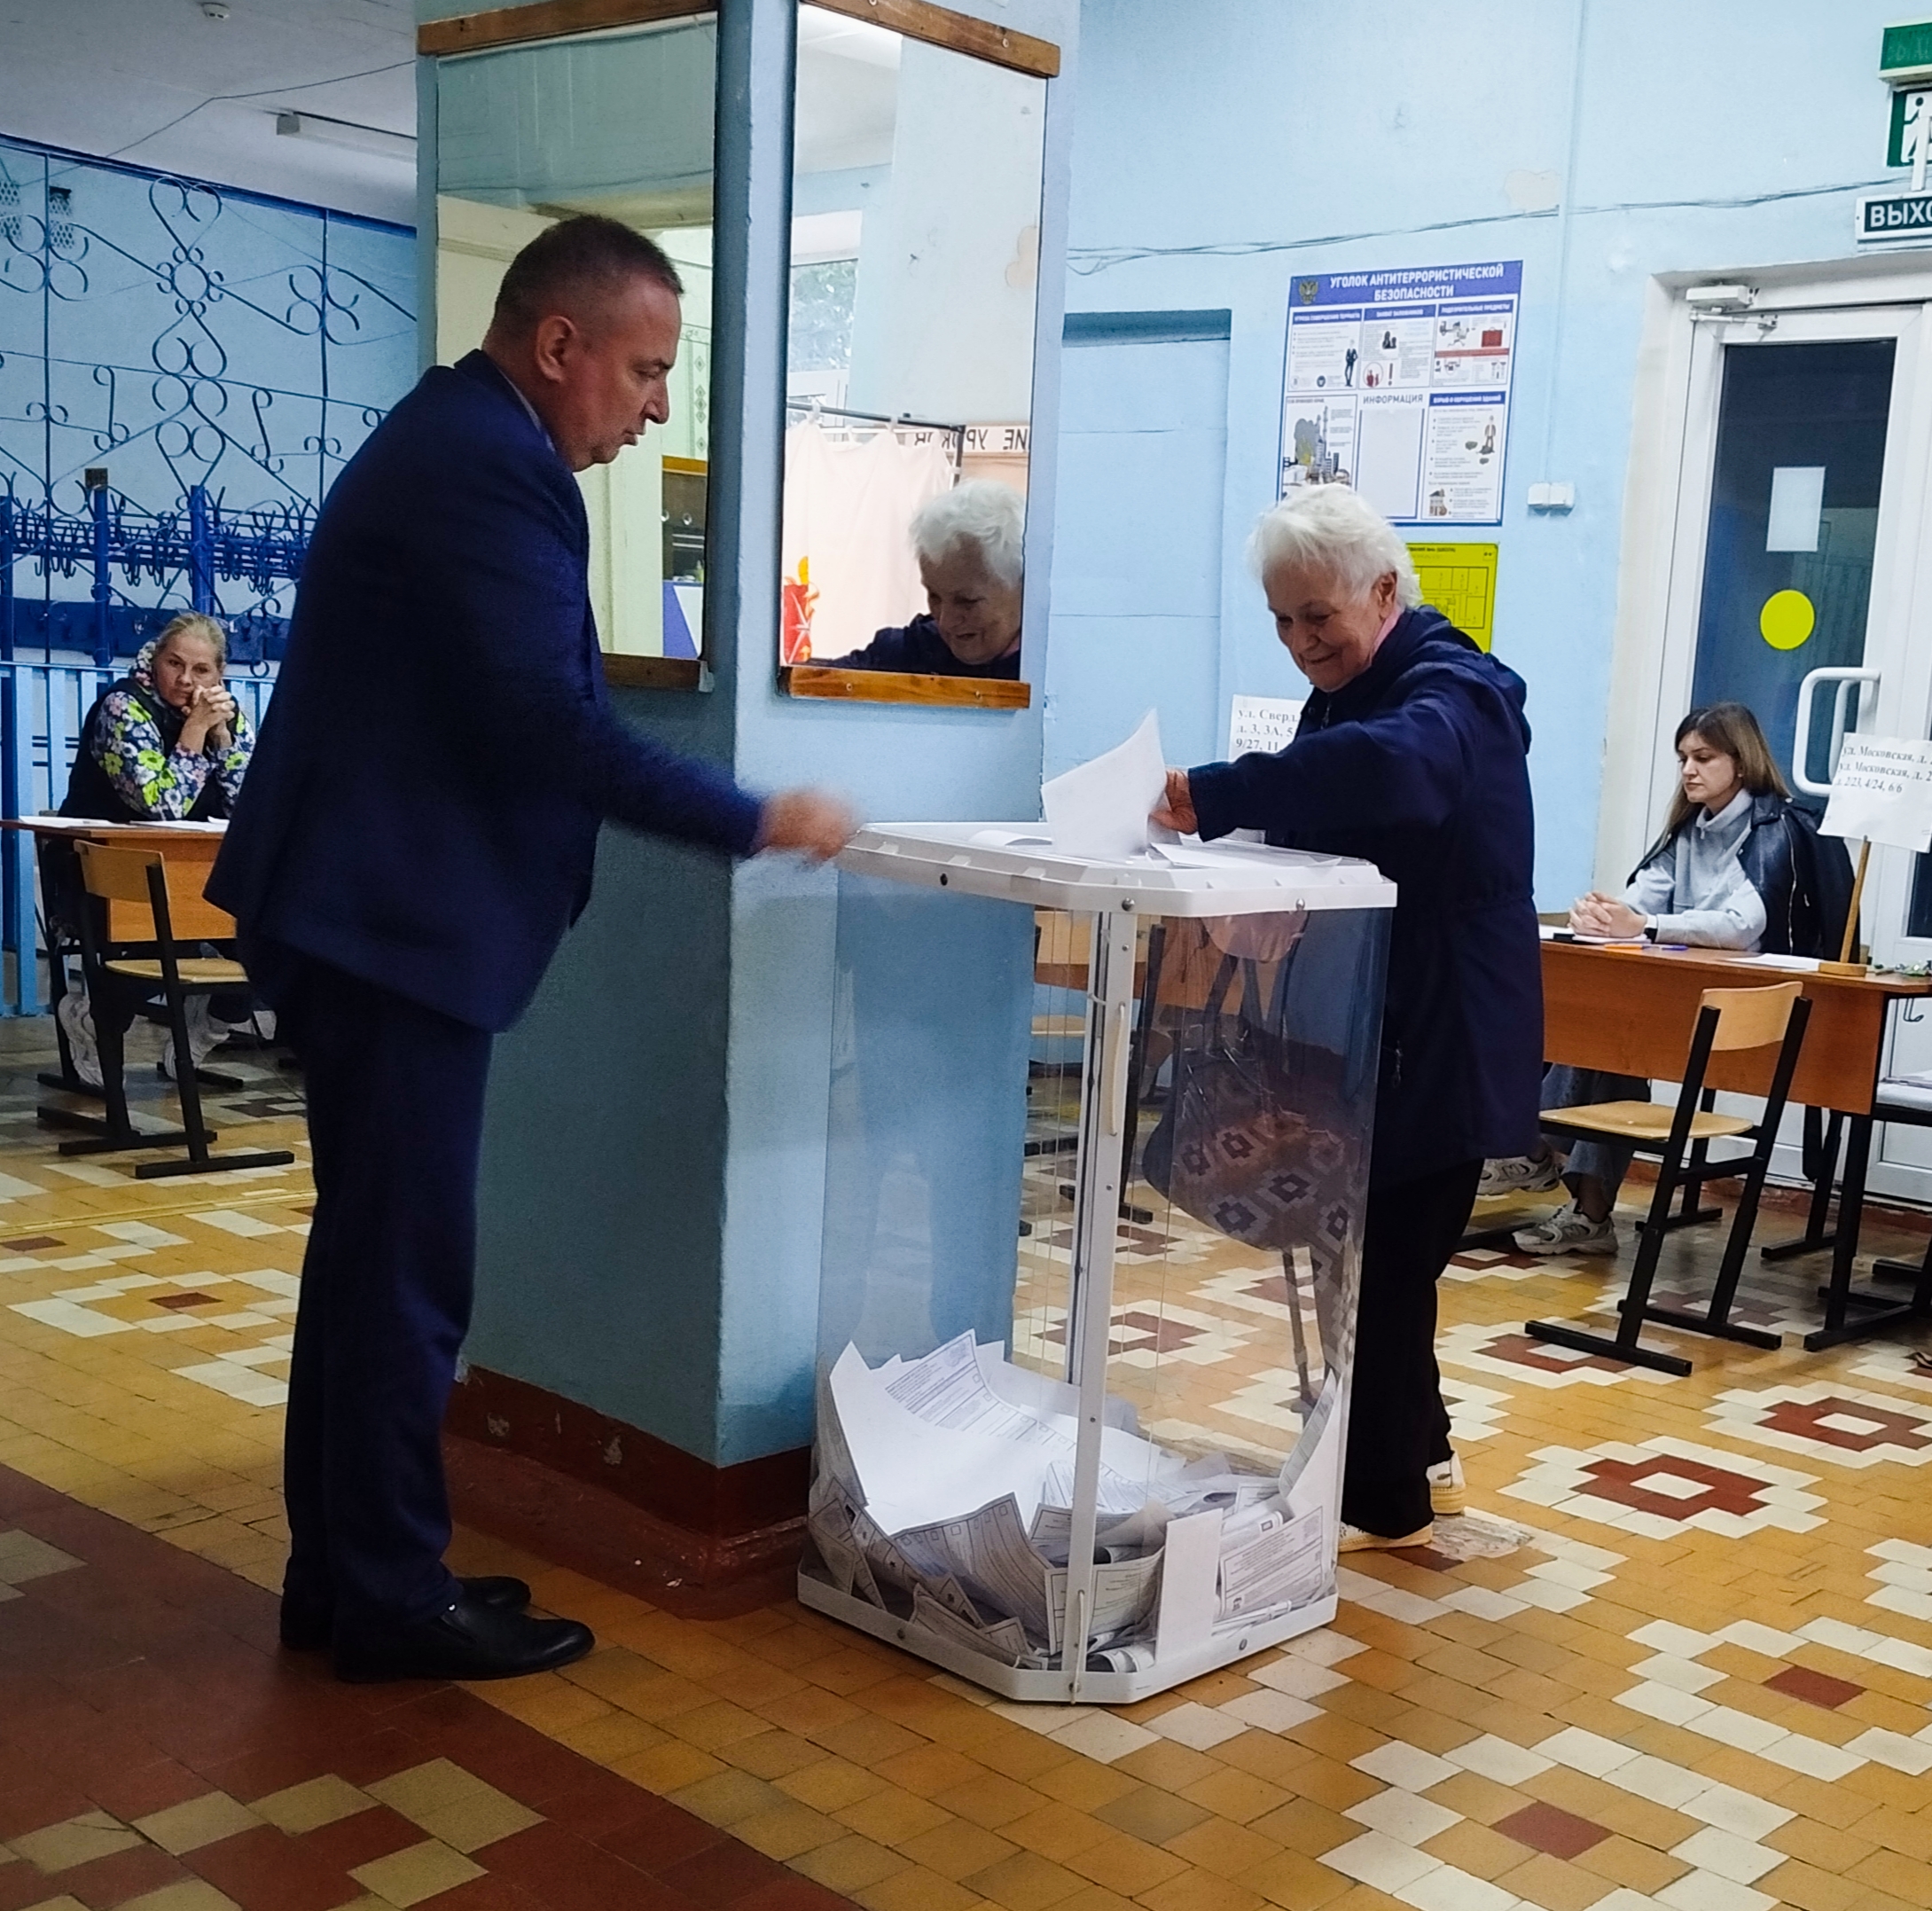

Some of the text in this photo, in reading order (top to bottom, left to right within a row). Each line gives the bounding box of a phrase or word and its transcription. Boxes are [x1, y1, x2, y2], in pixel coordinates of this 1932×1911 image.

[1330, 263, 1505, 289] УГОЛОК АНТИТЕРРОРИСТИЧЕСКОЙ
[1373, 285, 1454, 302] БЕЗОПАСНОСТИ
[1363, 394, 1424, 405] ИНФОРМАЦИЯ
[1239, 710, 1255, 719] ул.
[1859, 746, 1914, 762] Московская,
[1856, 762, 1910, 778] Московская,
